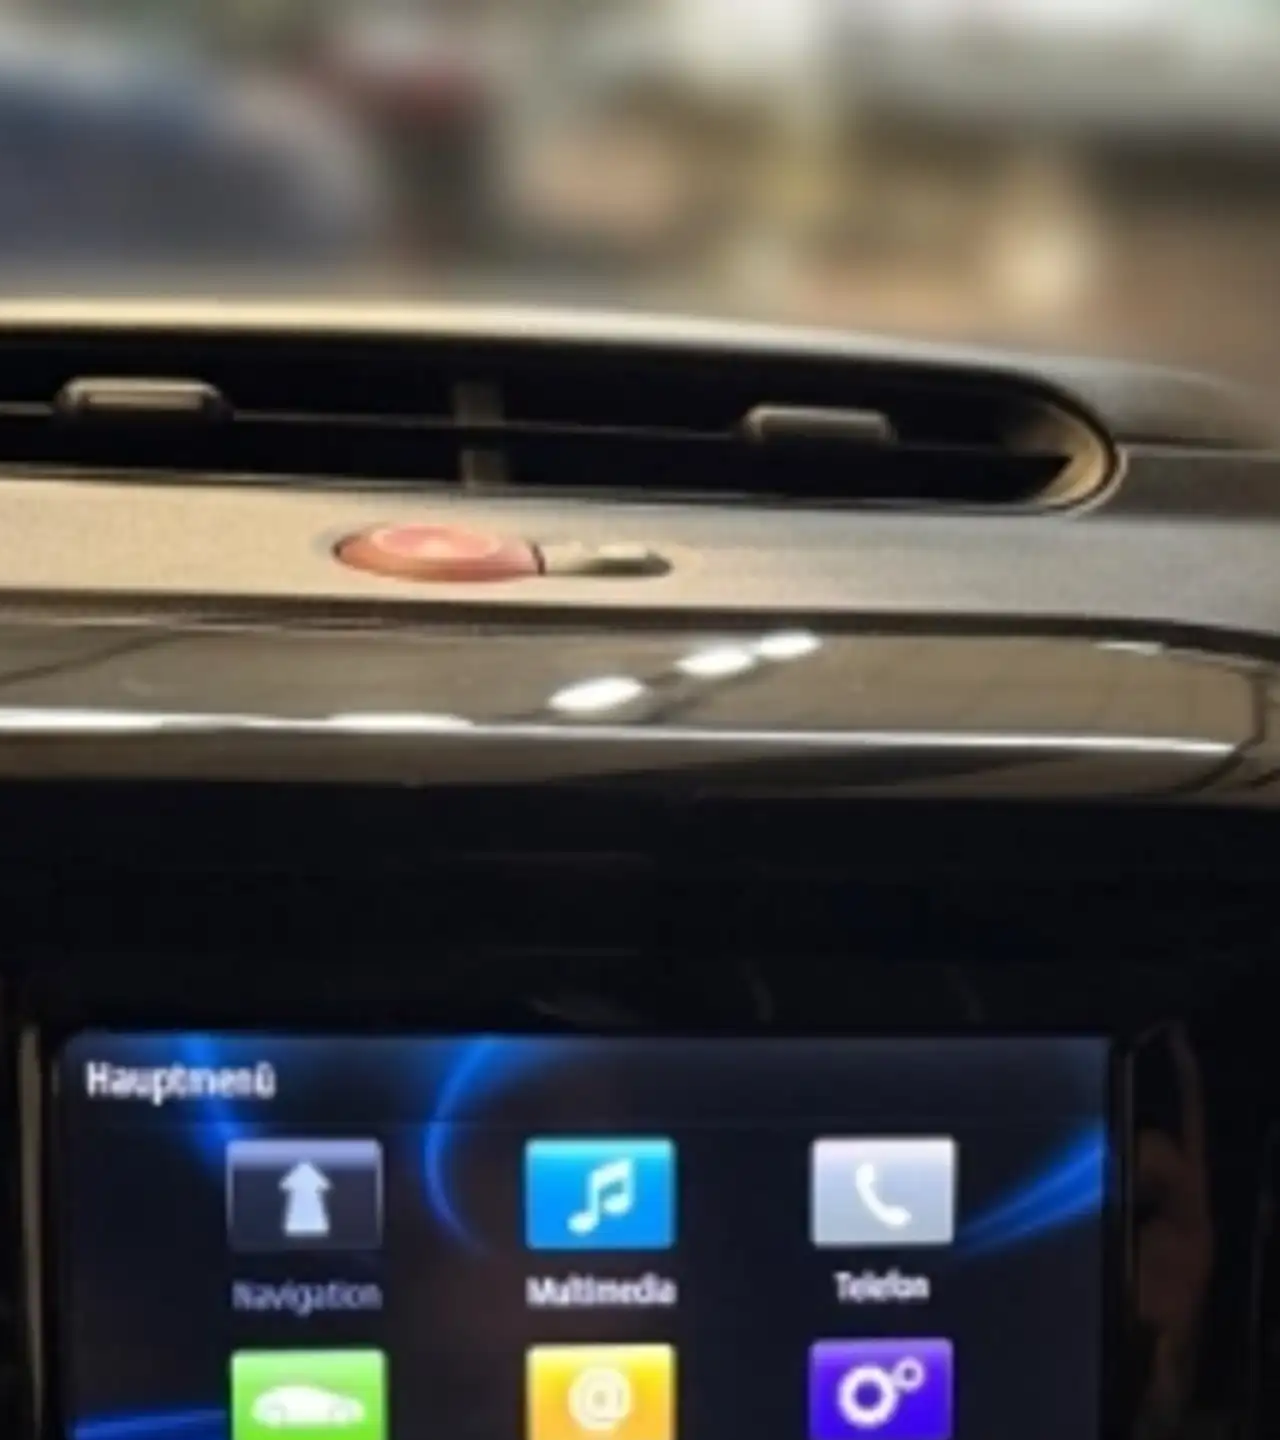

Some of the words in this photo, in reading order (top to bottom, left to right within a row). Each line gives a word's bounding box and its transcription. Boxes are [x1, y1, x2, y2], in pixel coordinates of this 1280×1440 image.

[85, 1060, 277, 1106] Hauptmenü
[230, 1277, 384, 1318] Navigation
[526, 1271, 677, 1309] Multimedia
[834, 1268, 930, 1303] Telefon
